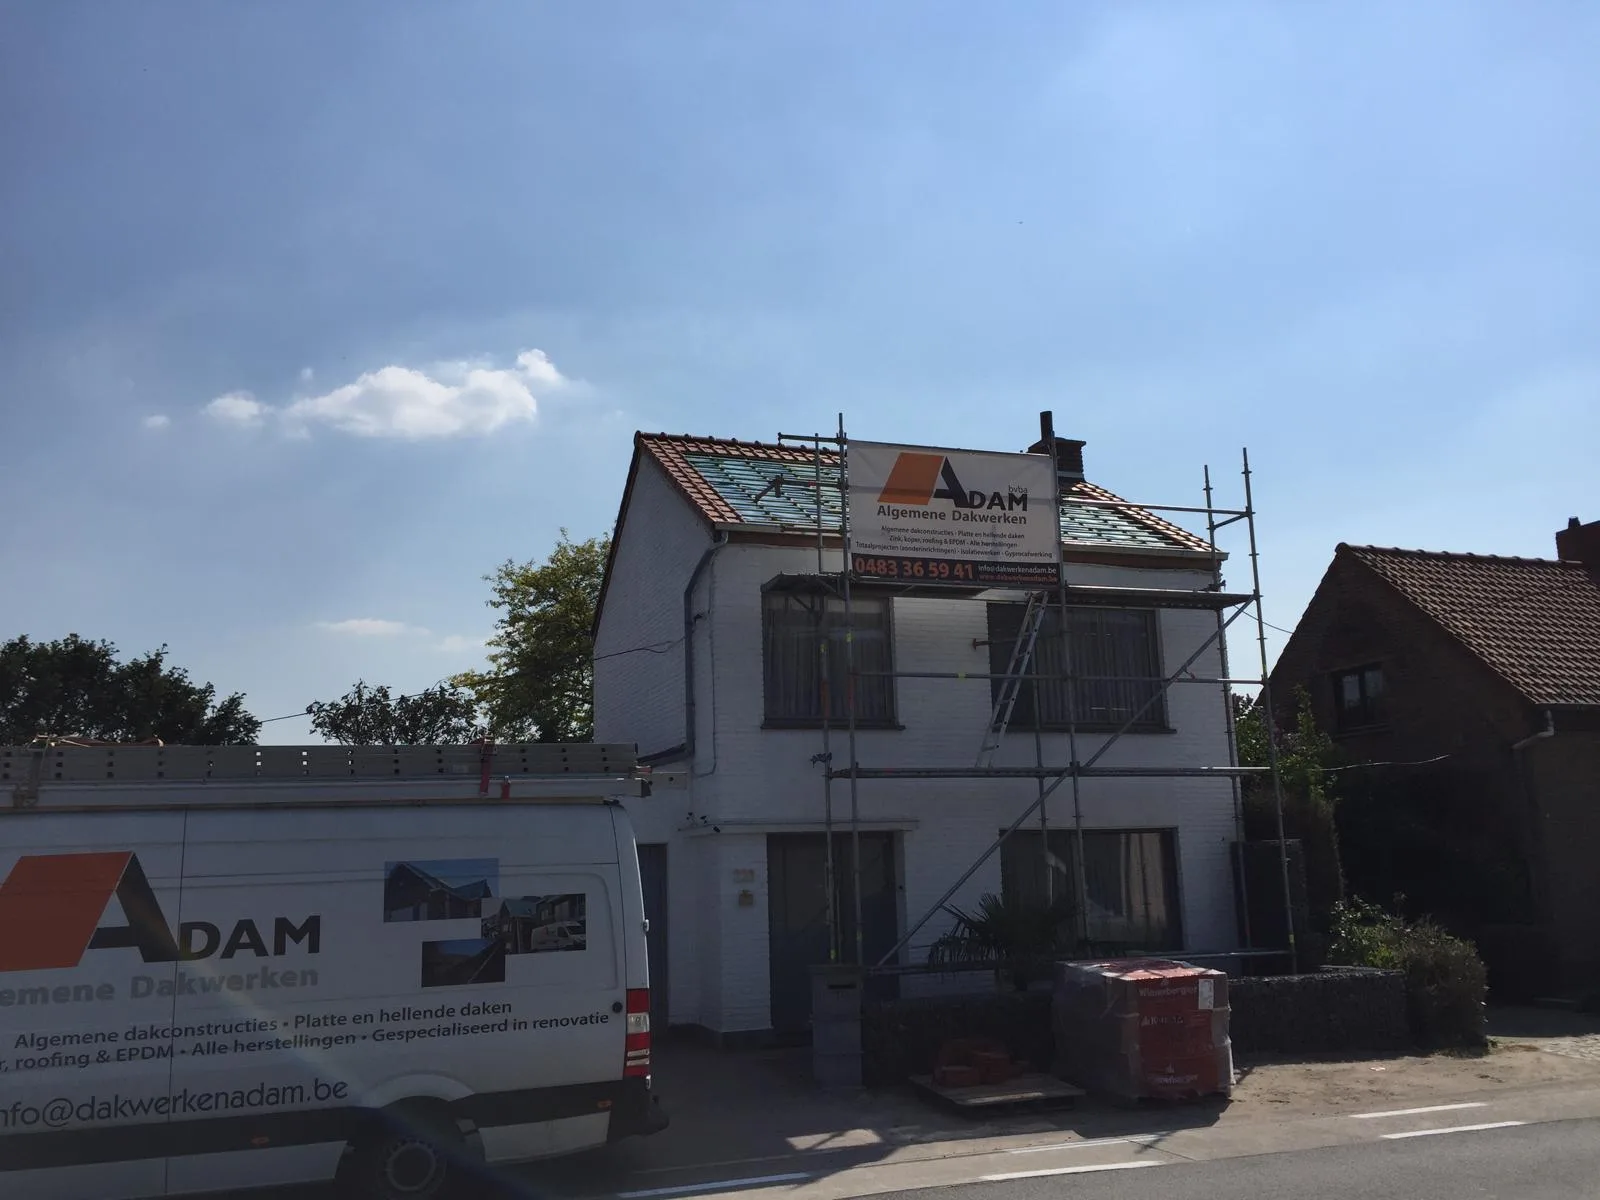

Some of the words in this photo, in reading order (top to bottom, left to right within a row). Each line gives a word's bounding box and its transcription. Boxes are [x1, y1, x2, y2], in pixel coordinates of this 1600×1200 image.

[933, 456, 1028, 511] ADAM
[1008, 485, 1028, 494] bvba
[877, 505, 946, 520] Algemene
[952, 510, 1027, 525] Dakwerken
[881, 525, 910, 533] Algemene
[855, 558, 898, 576] 0483
[902, 560, 924, 577] 36
[928, 561, 950, 578] 59
[954, 563, 974, 579] 41
[978, 564, 1056, 574] info@dakwerkenadam.be
[87, 851, 321, 963] ADAM
[130, 967, 319, 999] Dakwerken
[14, 1033, 118, 1052] Algemene
[124, 1018, 278, 1042] dakconstructies
[294, 1013, 347, 1029] Platte
[352, 1011, 374, 1024] en
[379, 1003, 456, 1023] hellende
[460, 1000, 512, 1017] daken
[15, 1052, 90, 1071] roofing
[95, 1049, 111, 1063] &
[116, 1044, 173, 1063] EPDM
[191, 1037, 229, 1056] Alle
[233, 1032, 357, 1054] herstellingen
[372, 1018, 508, 1044] Gespecialiseerd
[513, 1018, 528, 1031] in
[532, 1012, 609, 1030] renovatie
